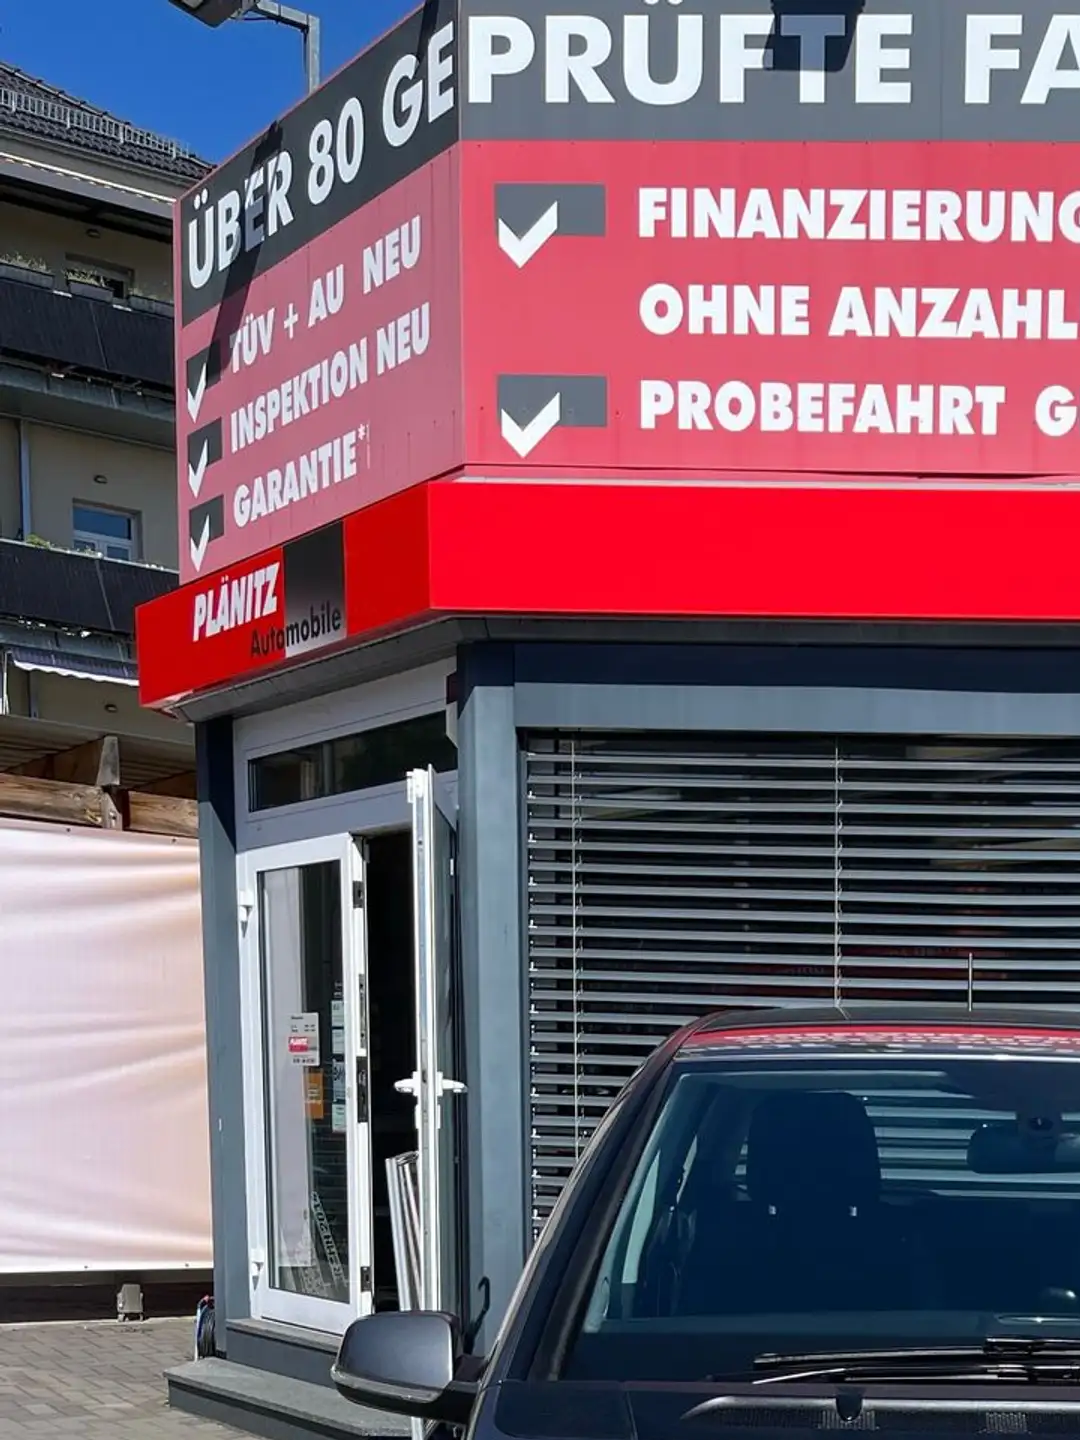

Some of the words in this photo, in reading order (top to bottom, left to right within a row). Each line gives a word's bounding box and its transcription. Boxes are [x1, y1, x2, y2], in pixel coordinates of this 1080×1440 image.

[187, 150, 294, 289] ÜBER
[308, 98, 364, 205] 80
[383, 0, 913, 148] GEPRÜFTE
[230, 312, 275, 374] TÜV
[307, 265, 345, 330] AU
[361, 214, 422, 296] NEU
[638, 282, 811, 336] OHNE
[230, 337, 368, 454] INSPEKTION
[376, 303, 431, 369] NEU
[638, 380, 1006, 436] PROBEFAHRT
[192, 560, 280, 642] PLÄNITZ
[250, 602, 342, 660] Automobile
